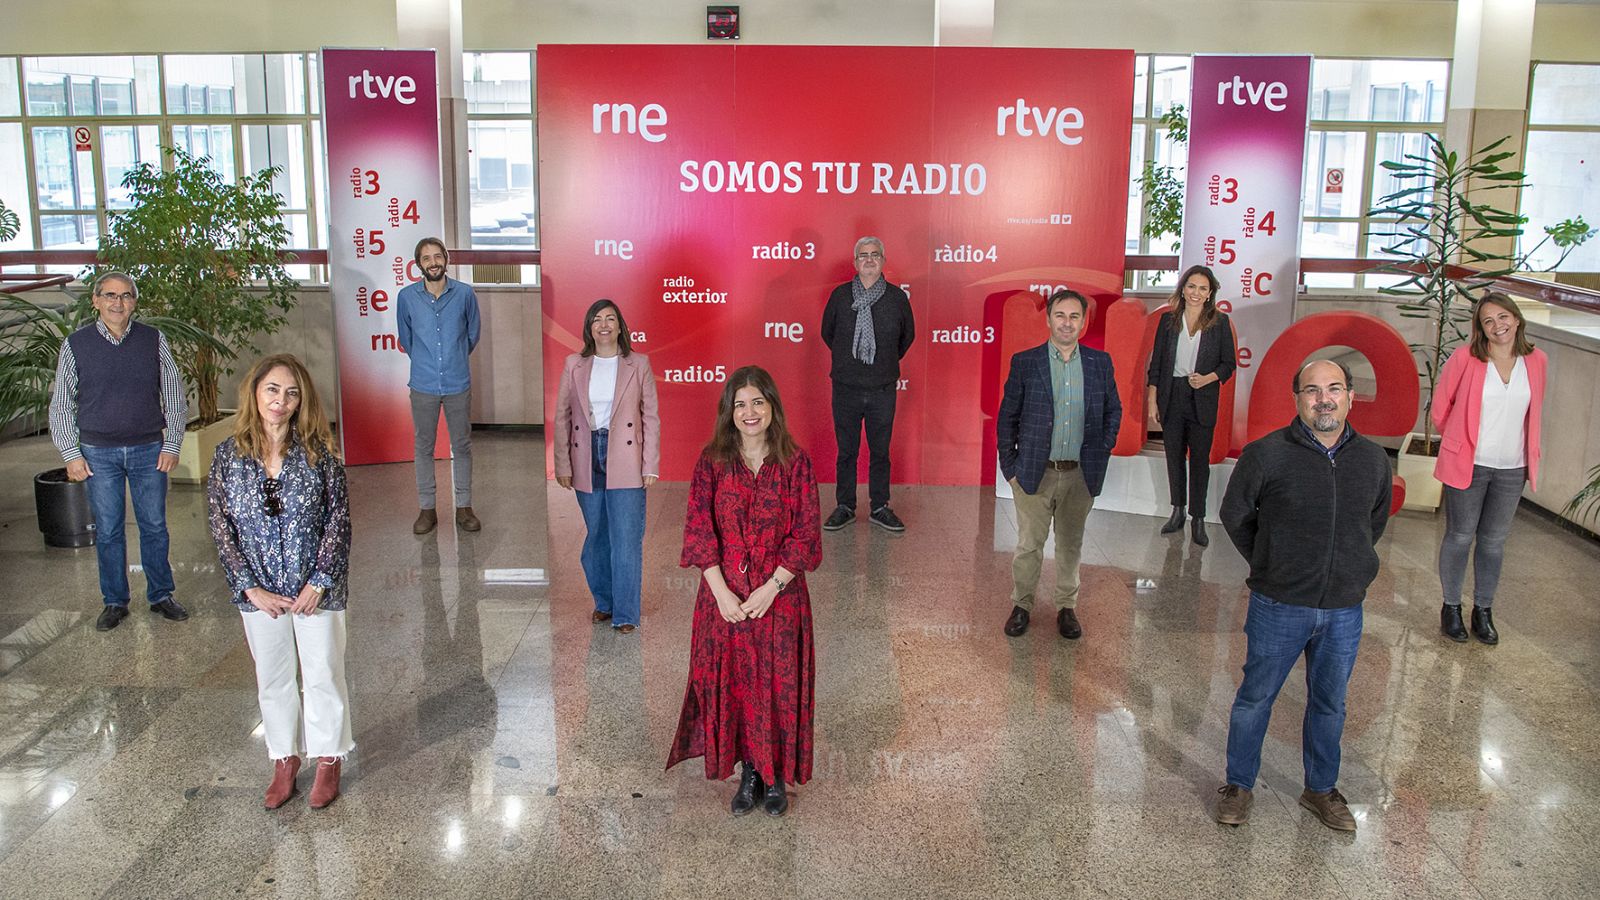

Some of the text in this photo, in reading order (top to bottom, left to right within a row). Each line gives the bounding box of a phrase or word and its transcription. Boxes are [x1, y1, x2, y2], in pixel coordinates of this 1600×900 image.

[348, 69, 417, 105] rtve
[1217, 75, 1288, 112] rtve
[592, 103, 667, 142] rne
[997, 98, 1084, 145] rtve
[350, 167, 381, 198] radio 3
[679, 159, 987, 196] SOMOS TU RADIO
[1208, 174, 1239, 206] radio 3
[387, 197, 421, 228] ràdio 4
[1242, 206, 1277, 238] ràdio 4
[353, 227, 386, 259] radio 5
[594, 239, 634, 260] rne
[752, 241, 816, 260] radio 3
[1204, 235, 1237, 267] radio 5
[391, 256, 404, 287] radio
[663, 275, 695, 288] radio
[1240, 266, 1253, 299] radio
[356, 286, 389, 317] radio e
[663, 288, 729, 304] exterior
[371, 333, 407, 353] rn
[764, 322, 804, 343] rne
[932, 325, 995, 344] radio 3
